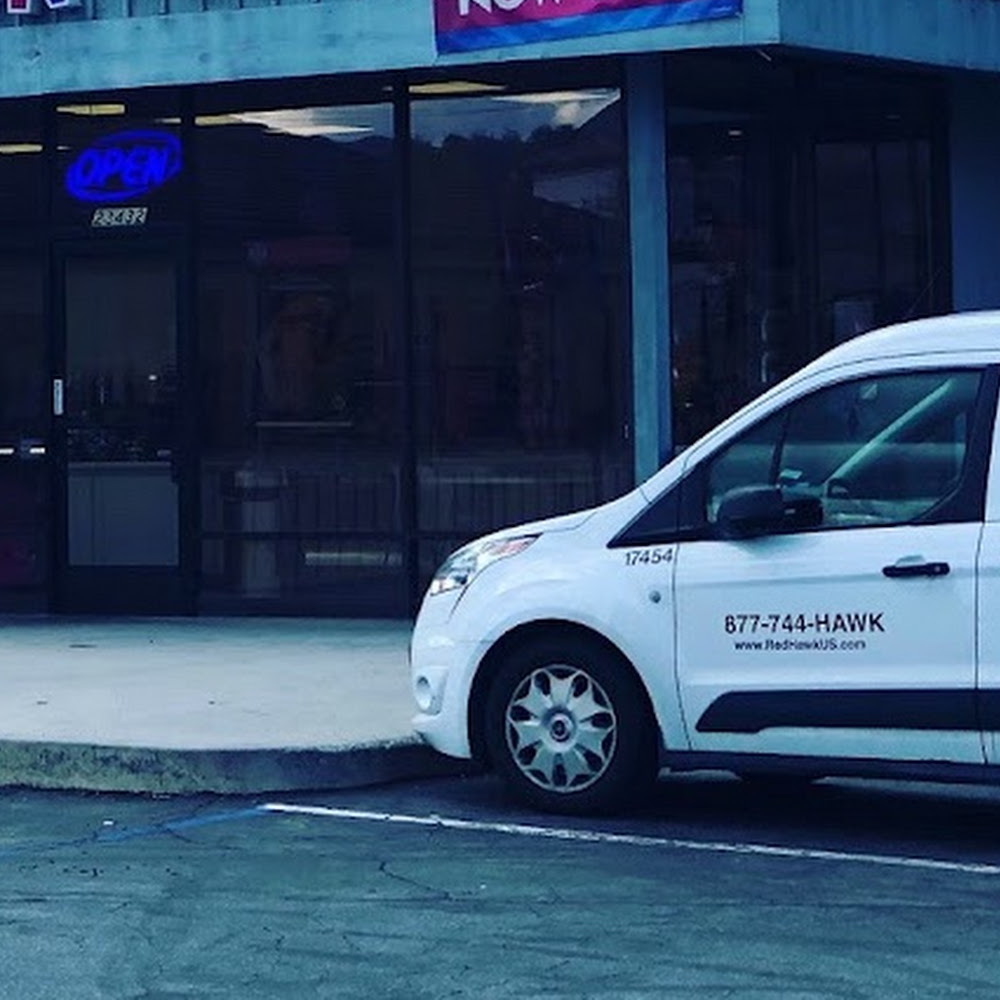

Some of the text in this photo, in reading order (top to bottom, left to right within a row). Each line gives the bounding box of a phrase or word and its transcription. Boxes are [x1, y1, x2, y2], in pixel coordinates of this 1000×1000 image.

[73, 147, 169, 188] OPEN
[625, 548, 673, 565] 17454
[724, 612, 885, 634] 877-744-HAWK
